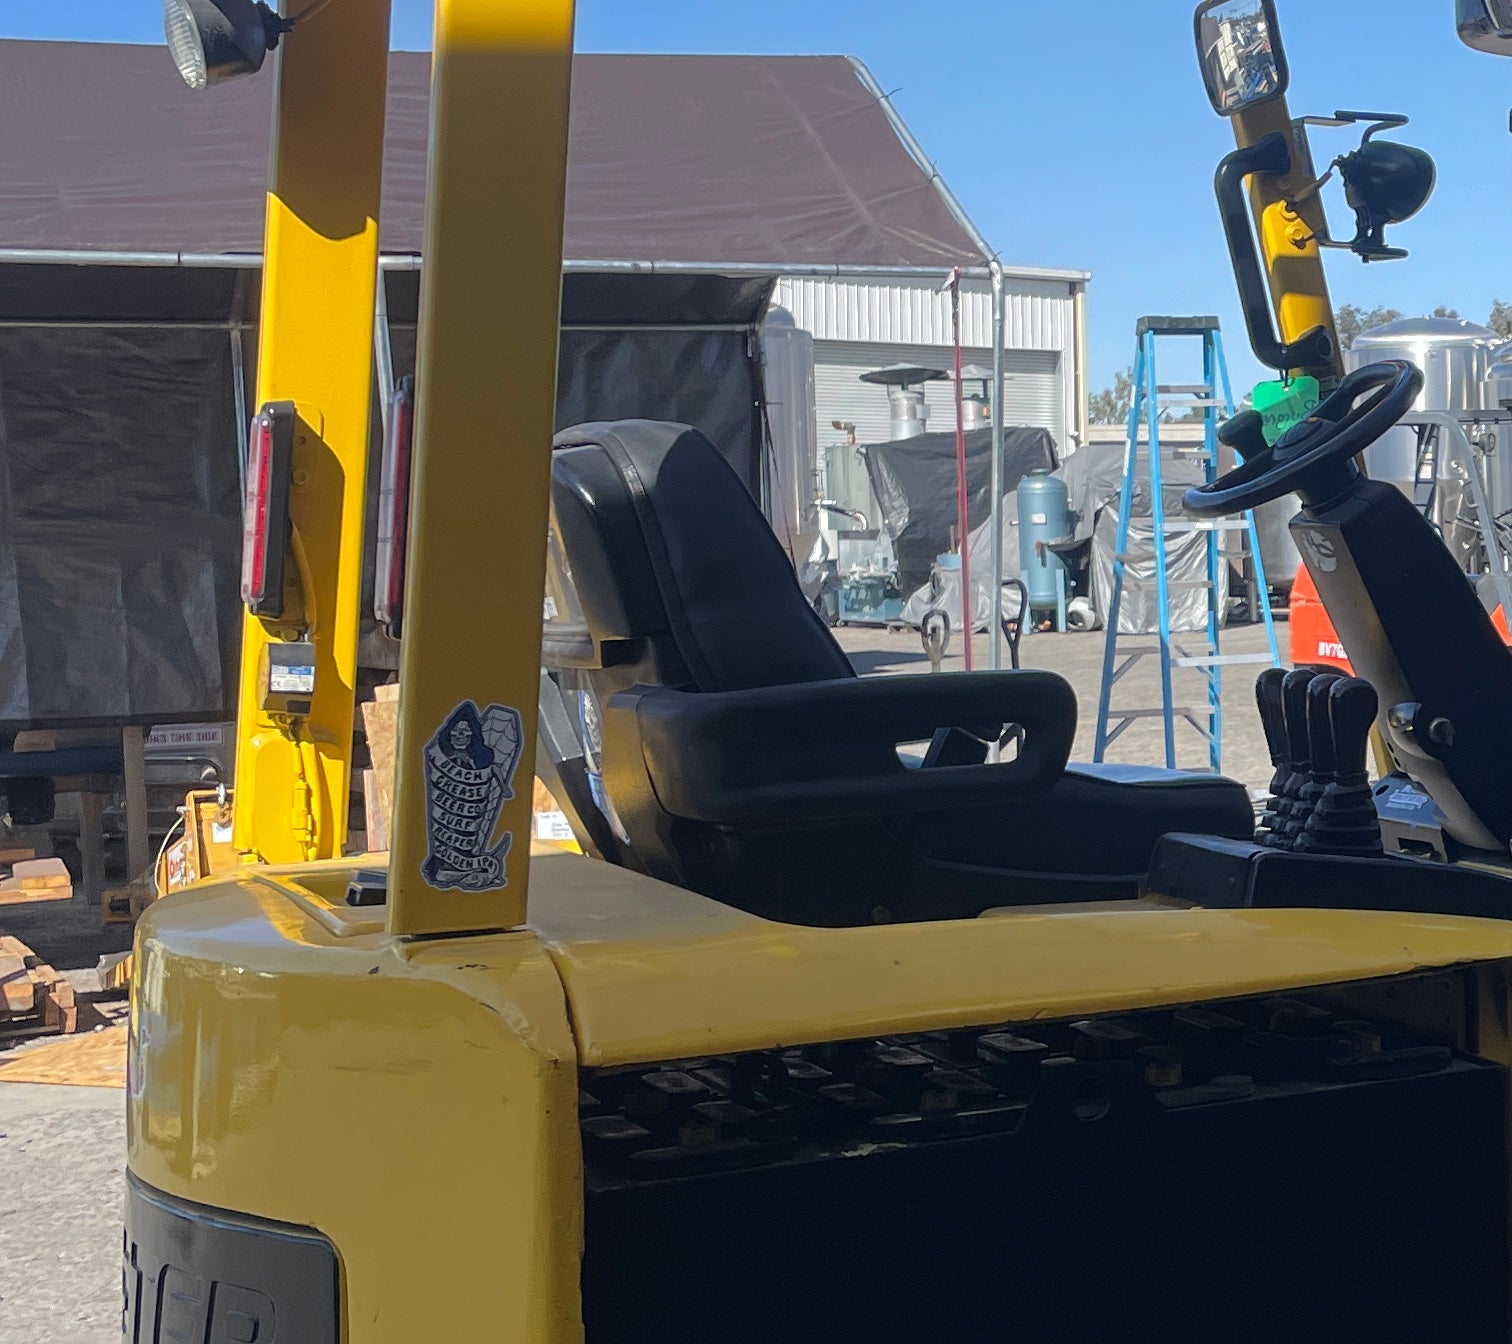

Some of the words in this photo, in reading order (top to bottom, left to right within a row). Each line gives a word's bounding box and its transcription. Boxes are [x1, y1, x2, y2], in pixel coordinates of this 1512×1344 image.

[440, 759, 483, 781] BEACH
[436, 775, 483, 798] GREASE
[438, 811, 474, 830] SURF
[433, 826, 475, 847] REAPER
[434, 844, 474, 869] GOLDEN
[477, 856, 494, 869] IPA
